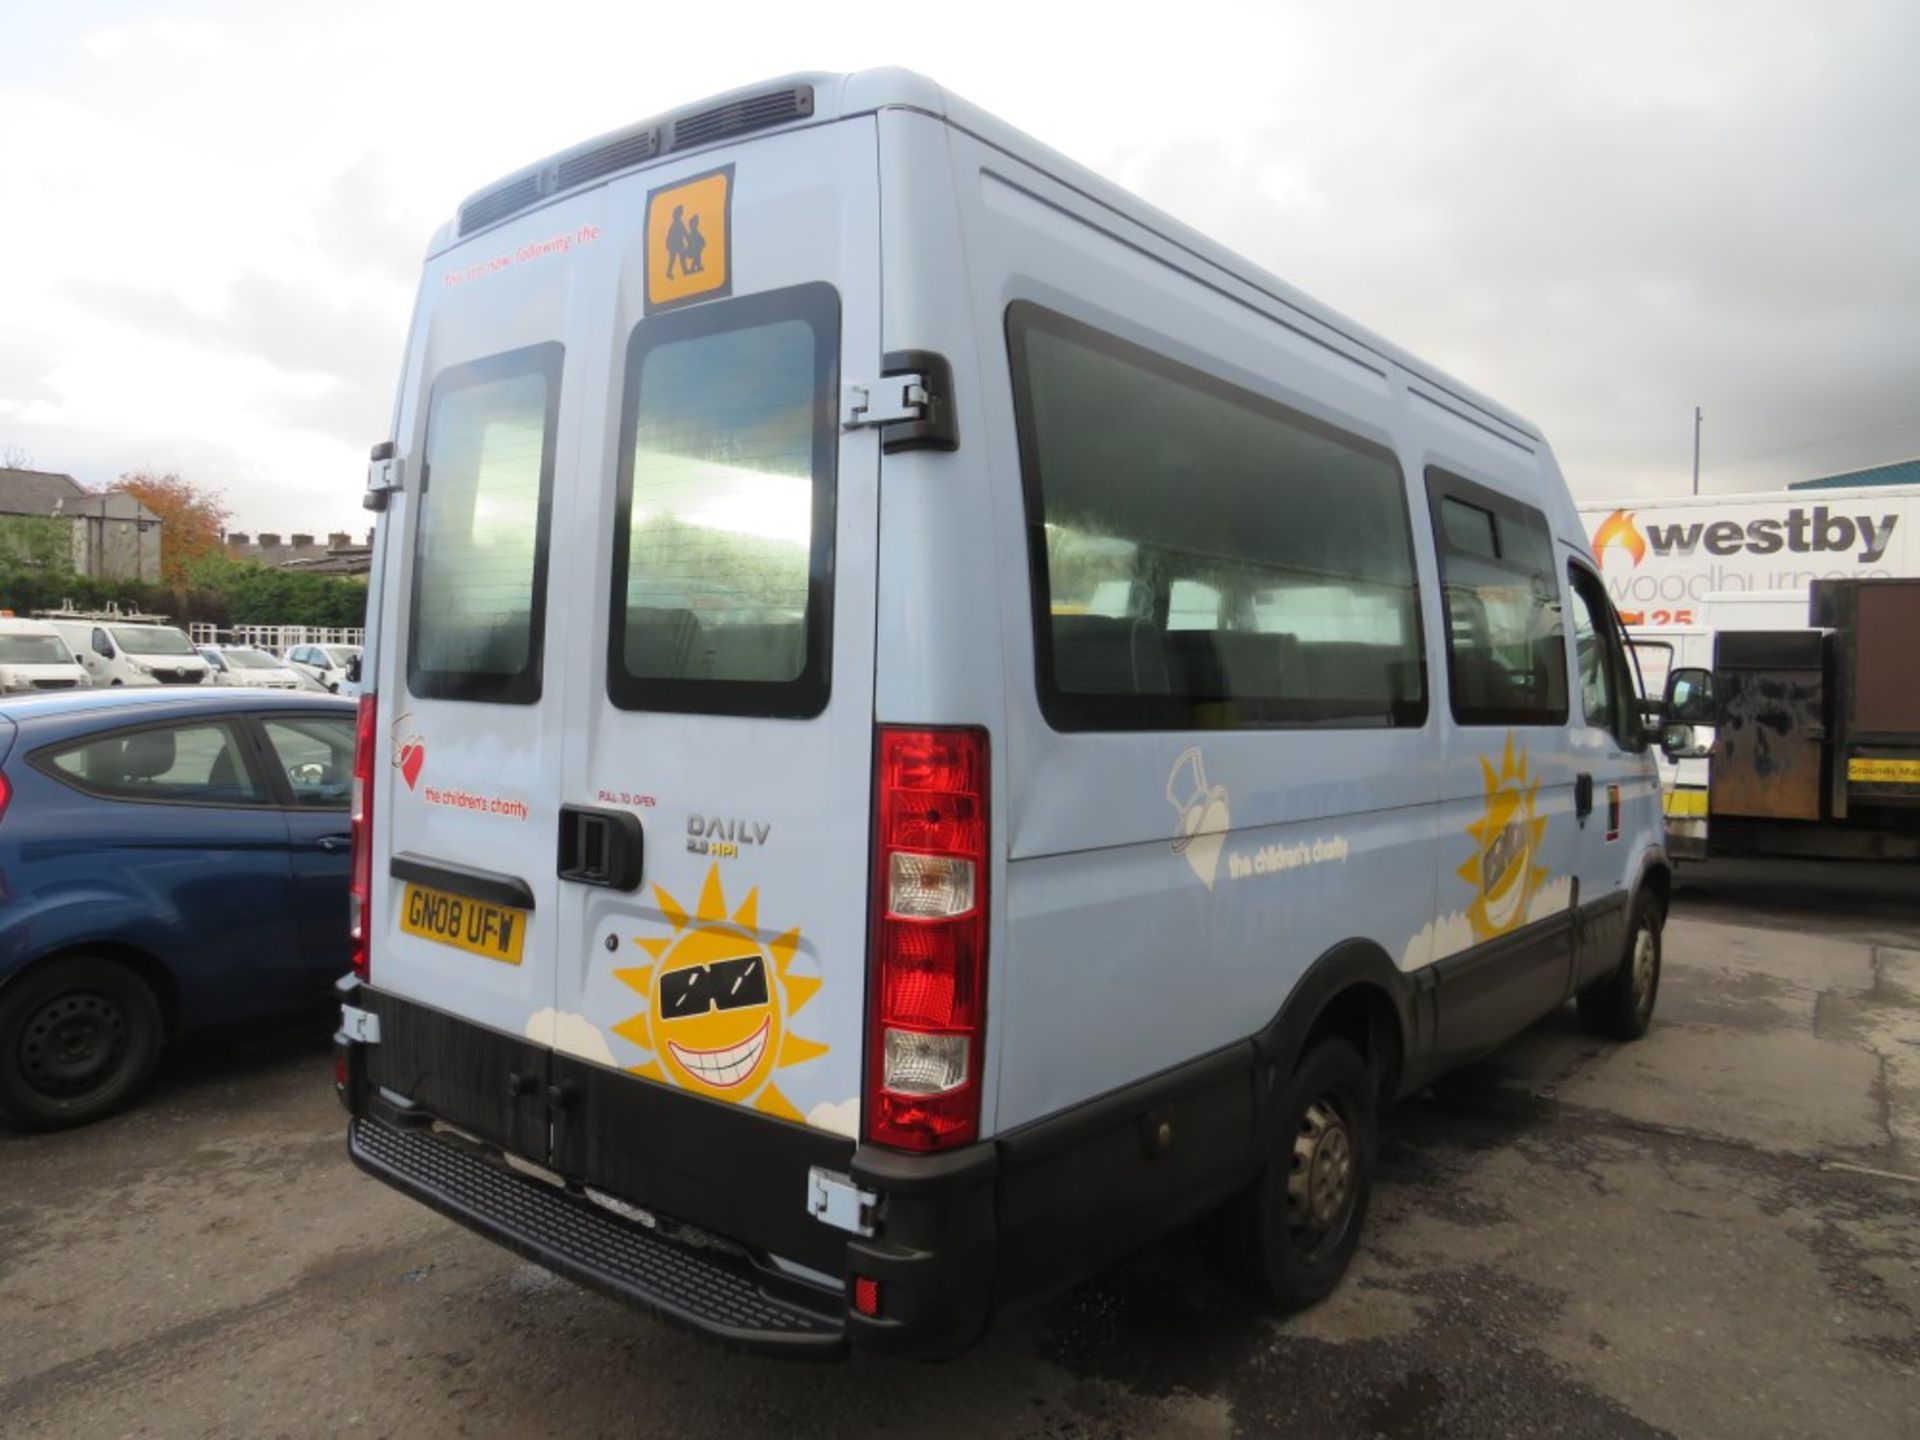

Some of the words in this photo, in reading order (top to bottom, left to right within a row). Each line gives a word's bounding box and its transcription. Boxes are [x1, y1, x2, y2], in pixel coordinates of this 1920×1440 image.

[577, 225, 600, 244] the
[1645, 505, 1899, 564] westby
[426, 787, 441, 803] the
[443, 790, 487, 812] children's
[491, 797, 529, 822] charity
[633, 794, 656, 807] OPEN
[686, 813, 770, 846] DAILY
[408, 889, 464, 938] GN08
[467, 903, 514, 953] UFW
